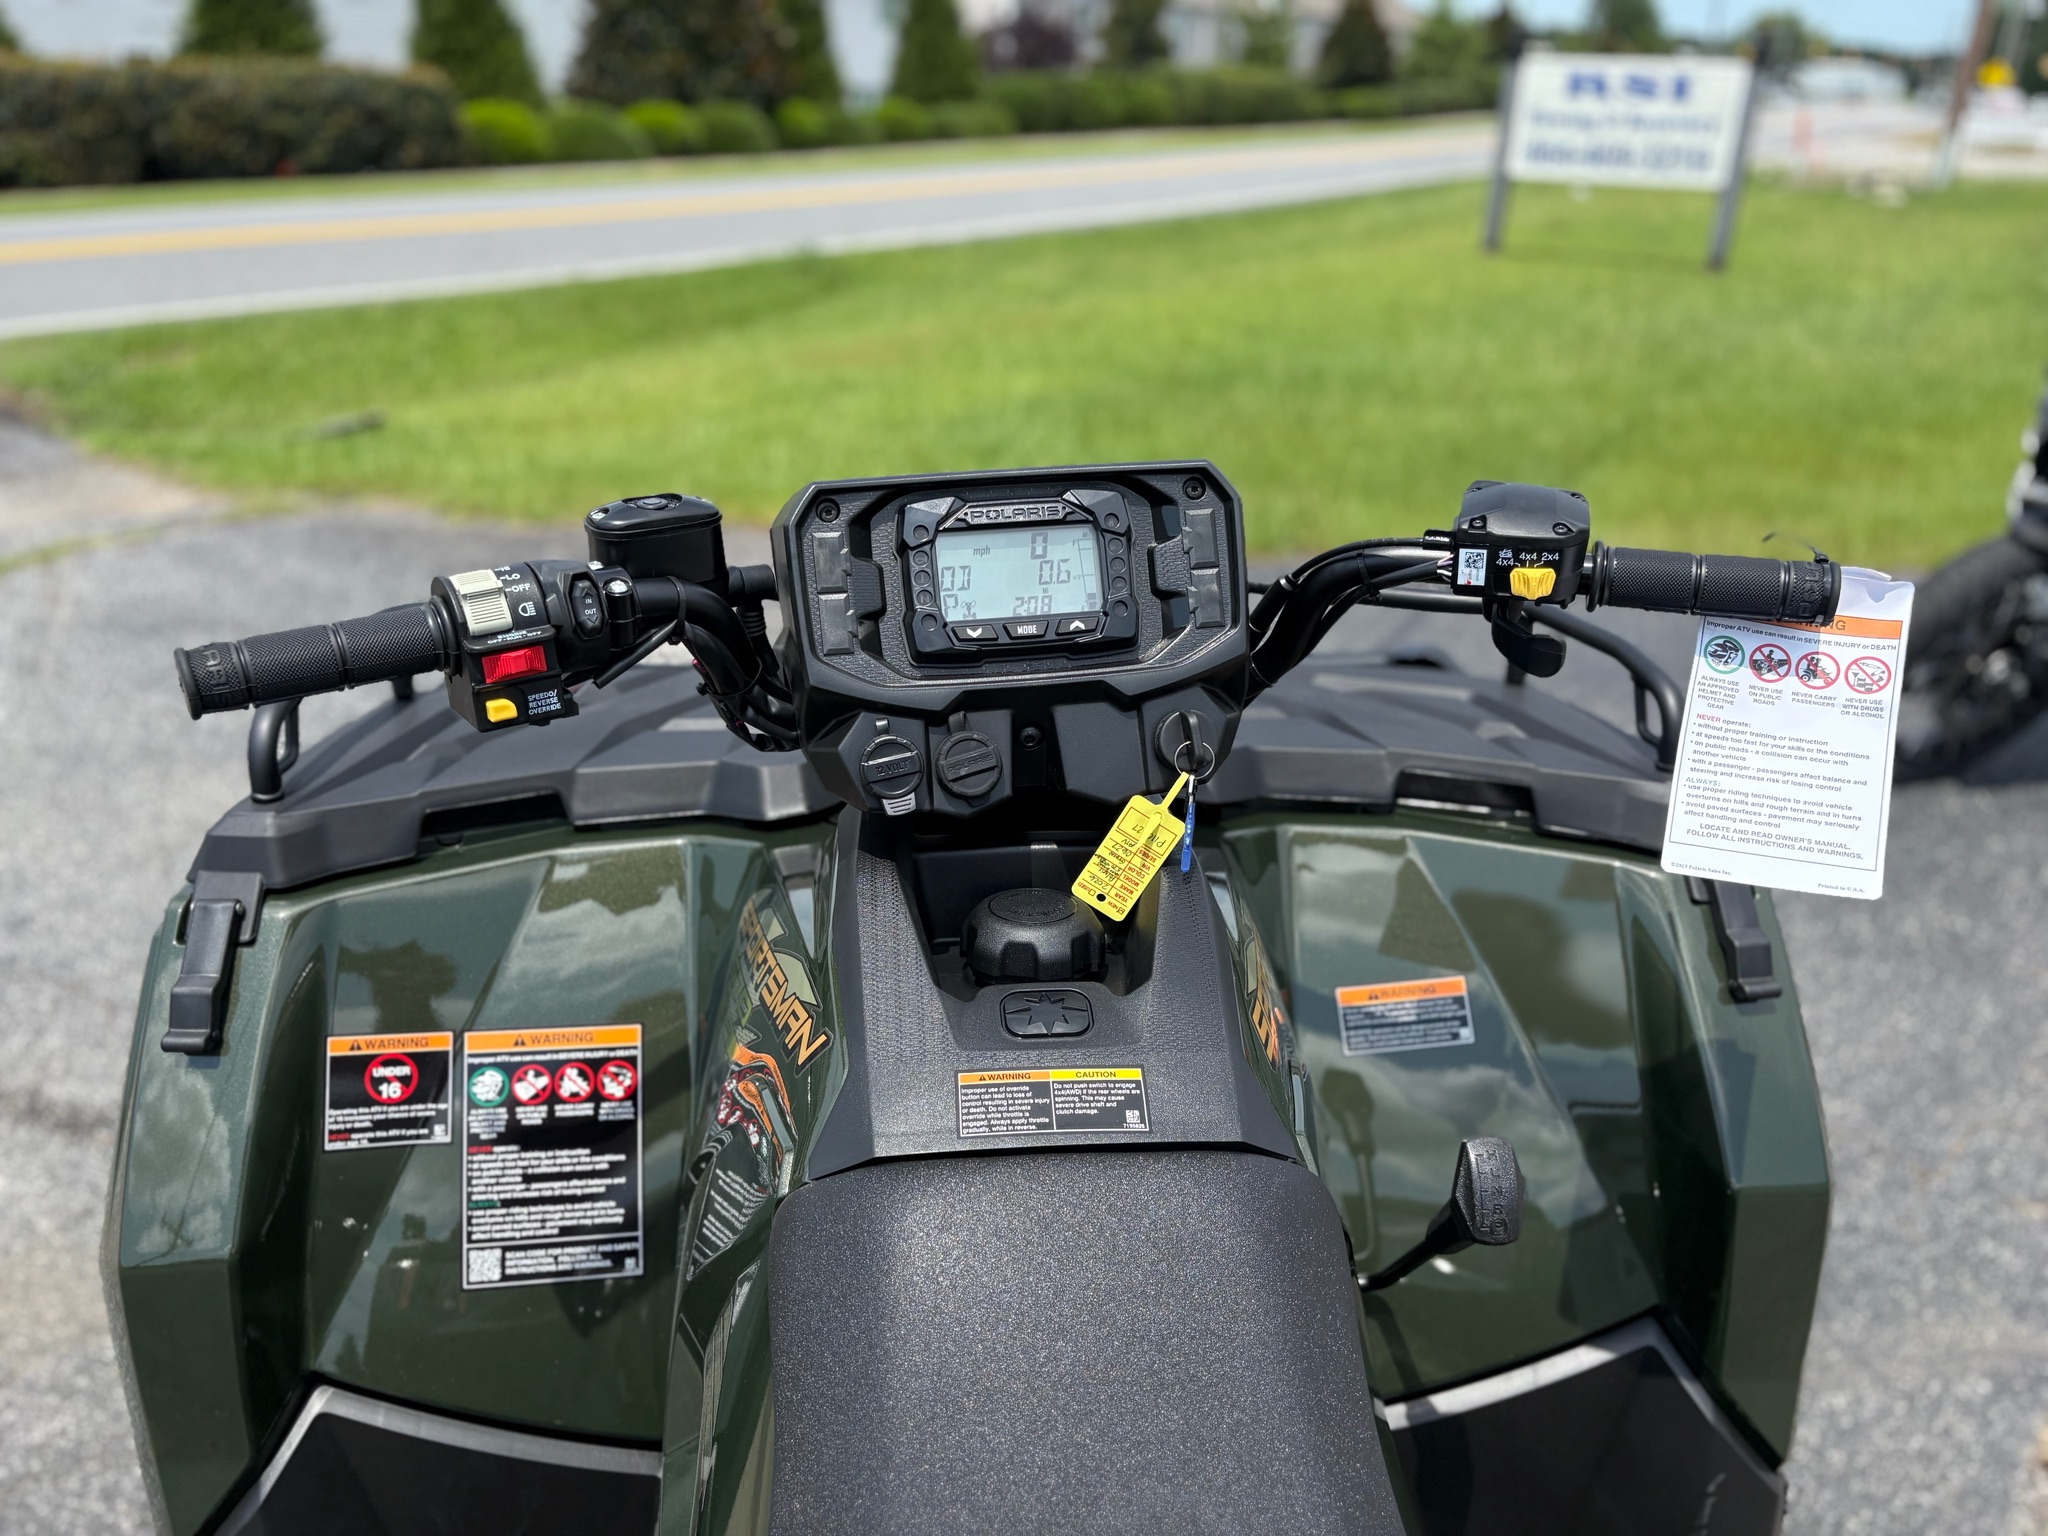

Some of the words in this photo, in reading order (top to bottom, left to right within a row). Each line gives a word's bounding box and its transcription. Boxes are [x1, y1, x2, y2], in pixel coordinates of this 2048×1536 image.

[970, 506, 1061, 522] POLARIS
[973, 546, 990, 556] mph
[1496, 558, 1514, 566] 4x4
[1039, 559, 1070, 585] 0.6
[512, 583, 530, 592] OFF
[1017, 625, 1037, 635] MODE
[1706, 619, 1736, 631] Improper
[1777, 633, 1796, 642] result
[1804, 637, 1832, 646] SEVERE
[1834, 640, 1861, 648] INJURY
[1701, 675, 1726, 684] ALWAYS
[1698, 687, 1722, 696] HELMET
[1707, 682, 1740, 693] APPROVED
[528, 689, 557, 701] SPEEDO/
[1698, 694, 1734, 705] PROTECTIVE
[529, 697, 558, 708] REVERSE
[1792, 697, 1835, 707] PASSENGERS
[529, 703, 562, 715] OVERRIDE
[1696, 713, 1721, 722] NEVER
[1698, 721, 1723, 731] without
[1724, 727, 1748, 736] proper
[1749, 730, 1777, 741] training
[1788, 736, 1828, 746] instruction
[1704, 732, 1729, 742] speeds
[1830, 749, 1870, 760] conditions
[1693, 748, 1719, 757] another
[1721, 752, 1747, 761] vehicle
[886, 760, 910, 774] VOLT
[1684, 809, 1704, 817] affect
[1705, 812, 1737, 823] handling
[1754, 819, 1781, 828] control
[1686, 828, 1719, 839] FOLLOW
[1737, 836, 1796, 850] INSTRUCTIONS
[1700, 823, 1731, 833] LOCATE
[1751, 830, 1773, 839] READ
[1774, 834, 1812, 844] OWNER'S
[1138, 849, 1157, 863] SERIES
[1127, 865, 1146, 879] COLOR
[1122, 874, 1140, 887] MODEL
[1119, 883, 1134, 895] MAKE
[1114, 892, 1129, 903] YEAR
[365, 1037, 429, 1049] WARNING
[530, 1032, 594, 1044] WARNING
[372, 1065, 411, 1077] UNDER
[379, 1082, 402, 1099] 16
